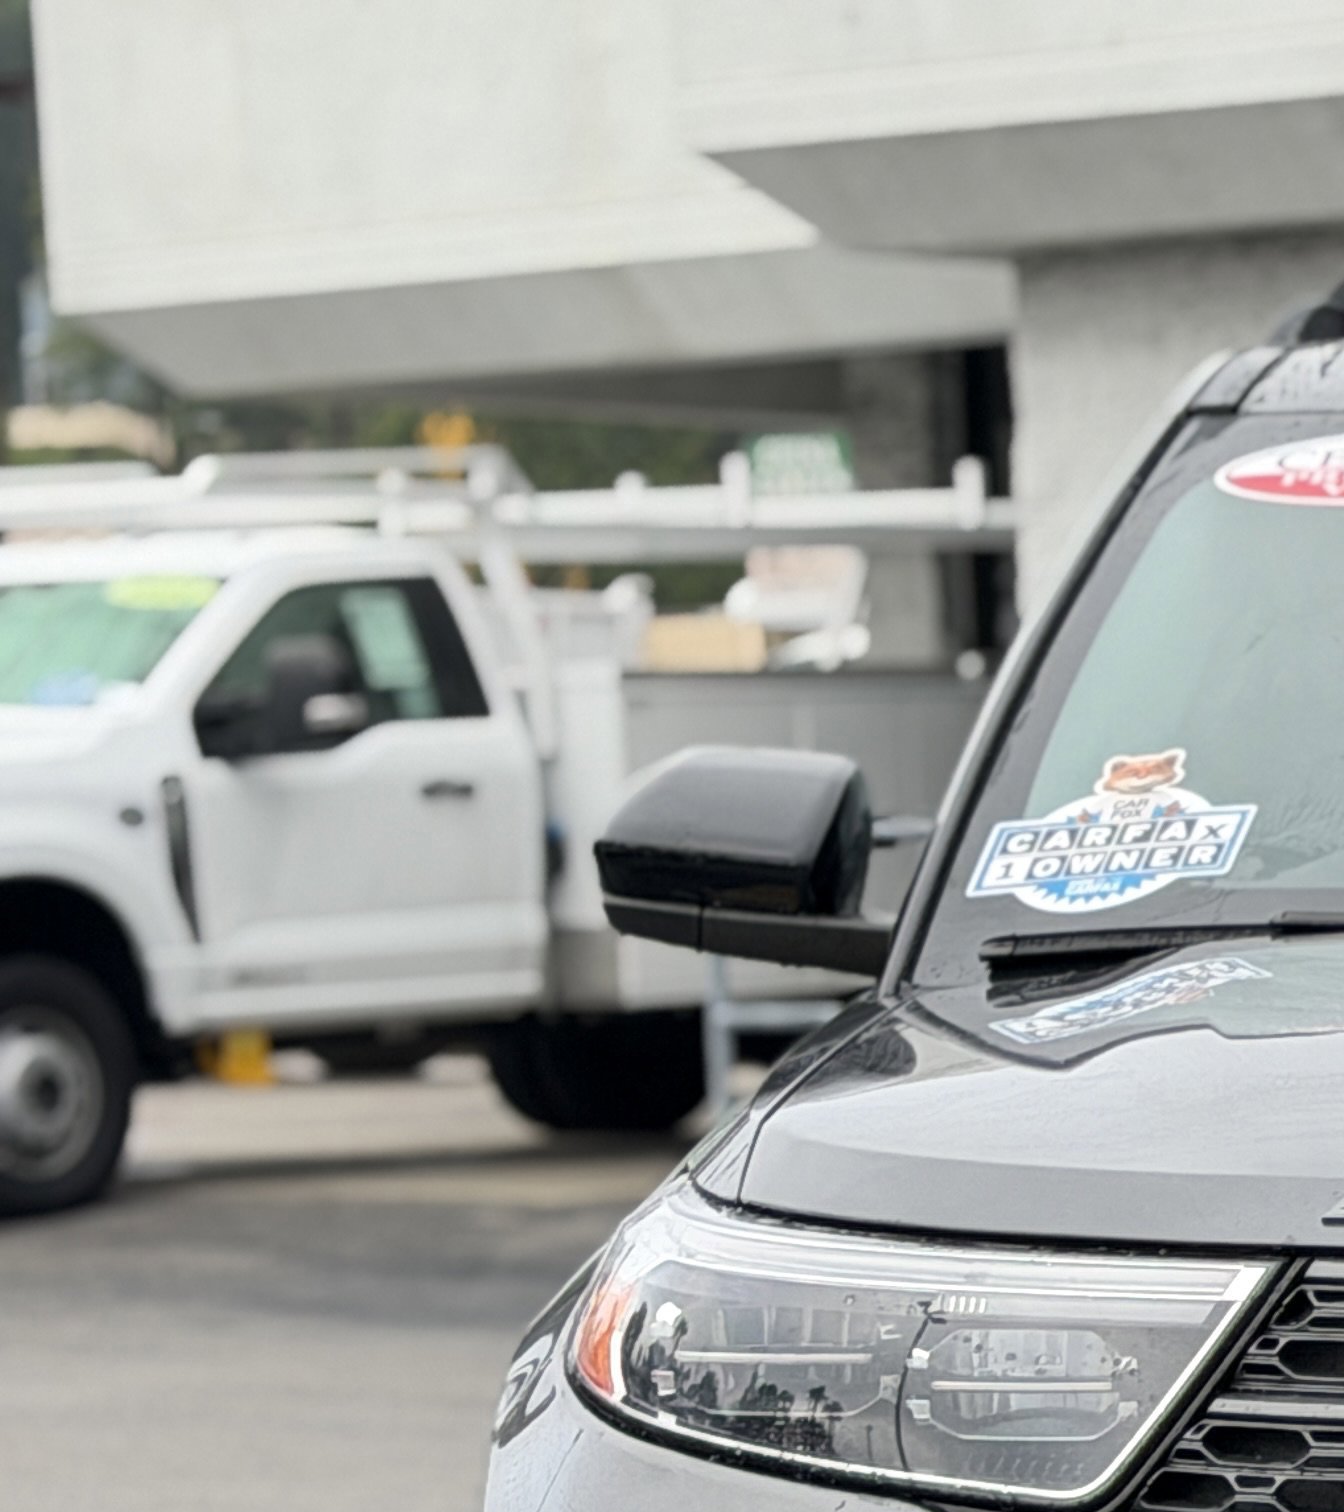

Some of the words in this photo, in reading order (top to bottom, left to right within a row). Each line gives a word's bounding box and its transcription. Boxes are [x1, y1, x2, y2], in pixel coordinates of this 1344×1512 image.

[1110, 807, 1144, 820] FOX
[1112, 798, 1150, 811] CAR
[1005, 820, 1229, 853] CARFAX
[1030, 845, 1219, 879] OWNER
